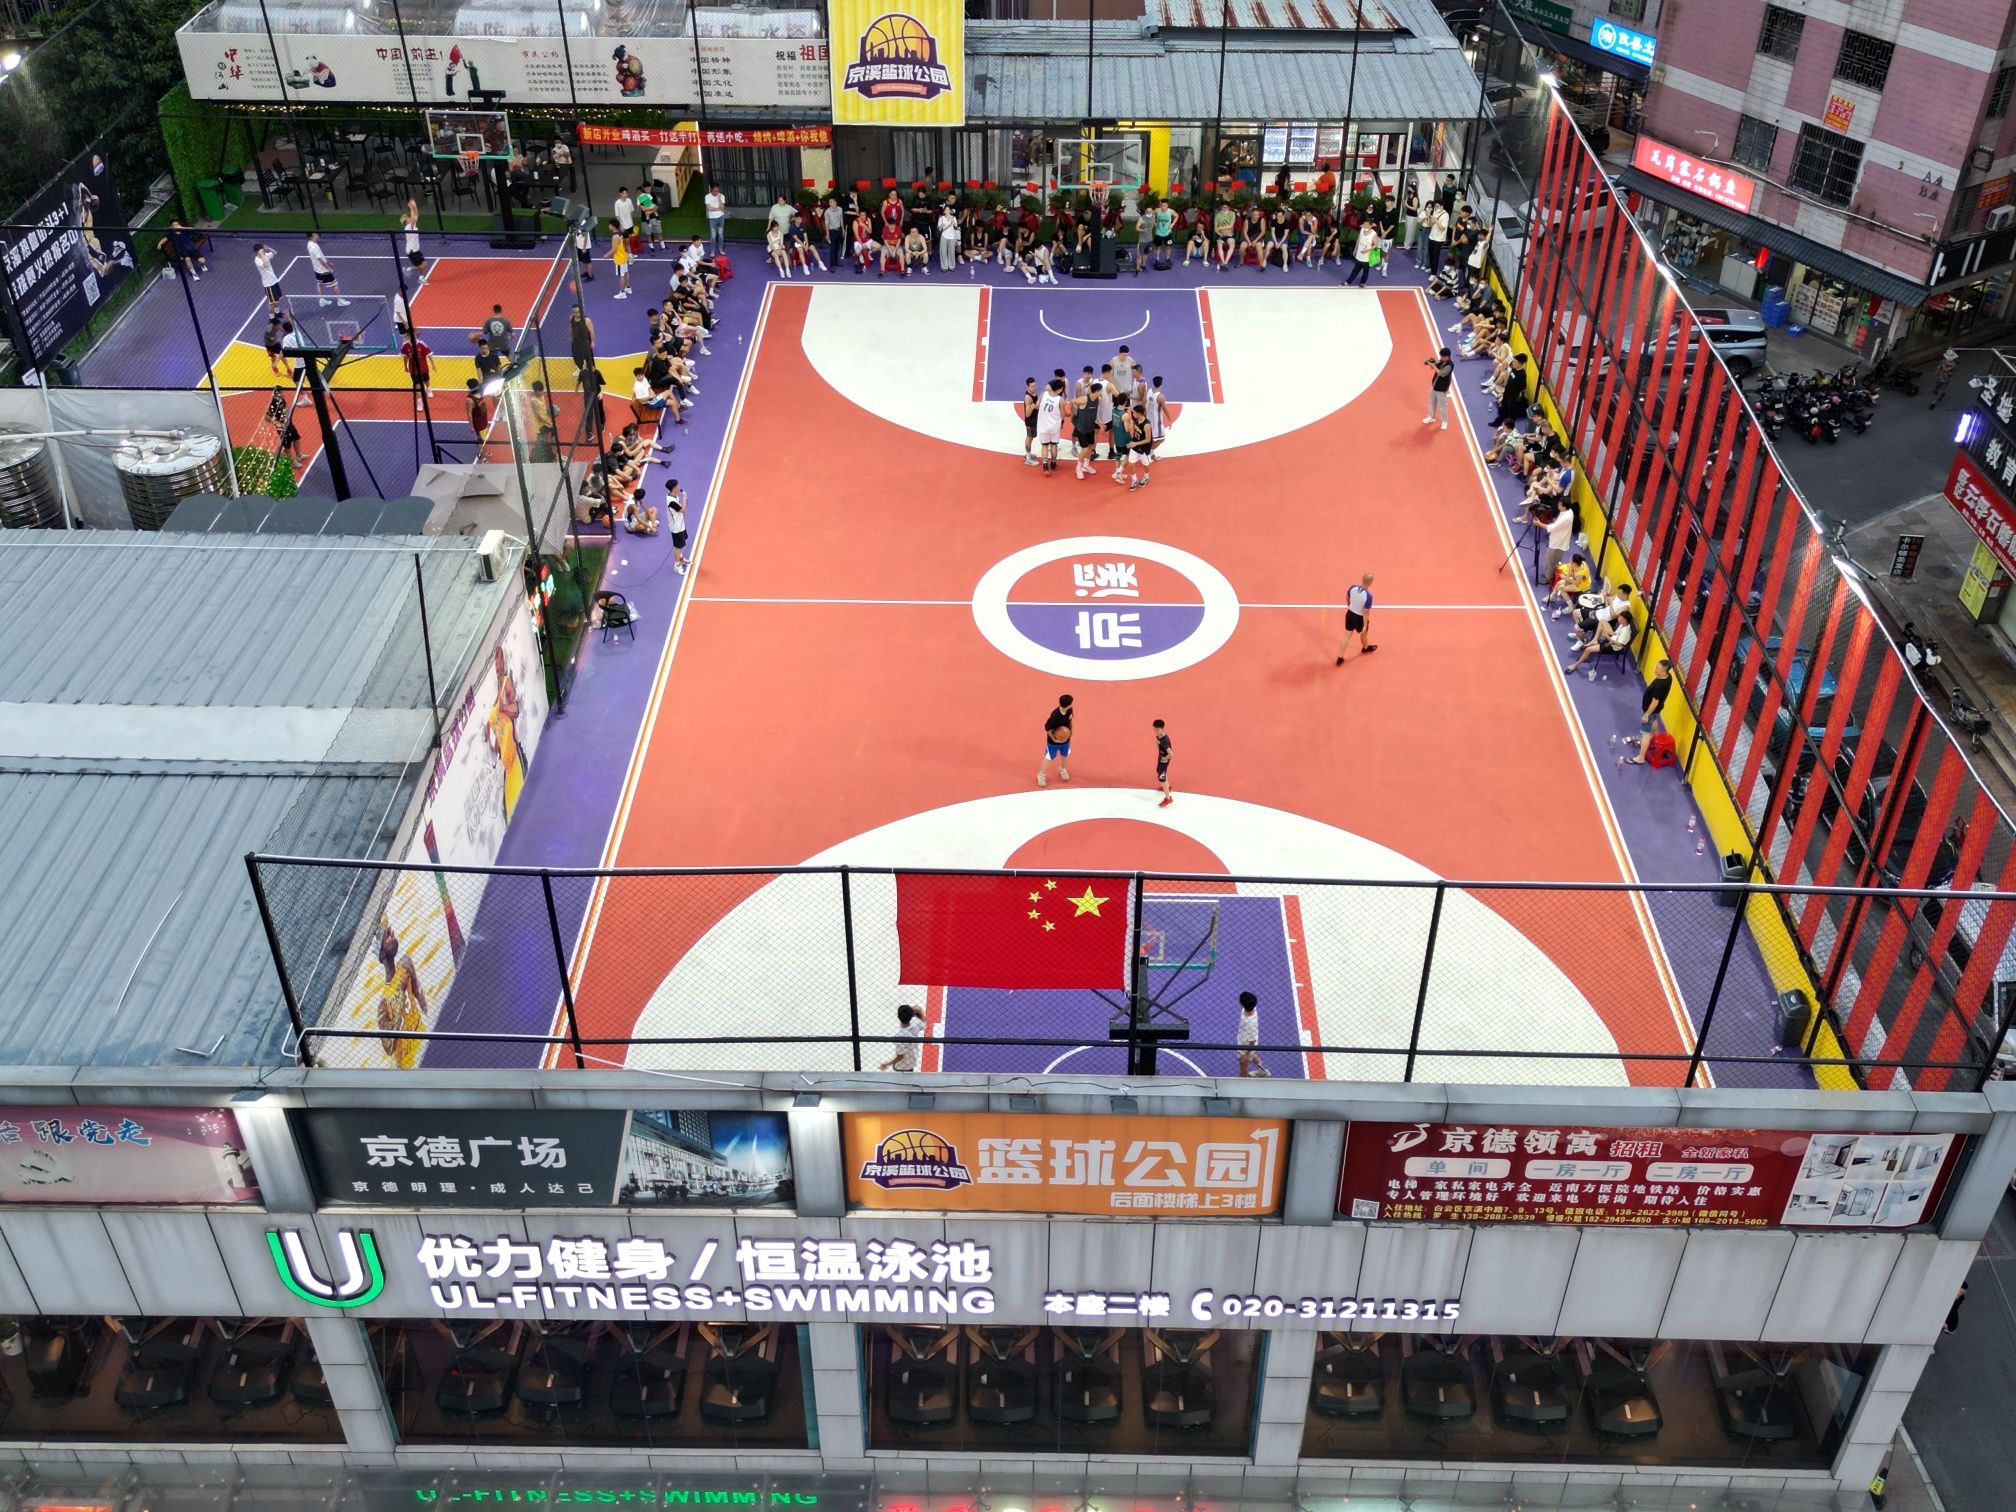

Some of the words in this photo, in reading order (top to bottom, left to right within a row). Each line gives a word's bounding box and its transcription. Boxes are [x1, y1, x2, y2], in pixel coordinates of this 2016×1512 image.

[847, 63, 949, 87] 京溪篮球公园
[360, 1135, 567, 1169] 京德广场
[1439, 1127, 1602, 1156] 京德领寓
[1610, 1140, 1663, 1159] 招租
[1680, 1147, 1751, 1160] 全新家私
[864, 1164, 969, 1180] 京溪篮球公园
[977, 1137, 1262, 1188] 篮球公园
[1647, 1164, 1749, 1181] 二房一厅
[1110, 1192, 1258, 1209] 后面楼梯上3楼
[416, 1235, 675, 1281] 优力健身
[736, 1236, 993, 1283] 恒温泳池
[431, 1283, 996, 1315] UL-FITNESS+SWIMMING
[1222, 1295, 1461, 1321] 020-31211315
